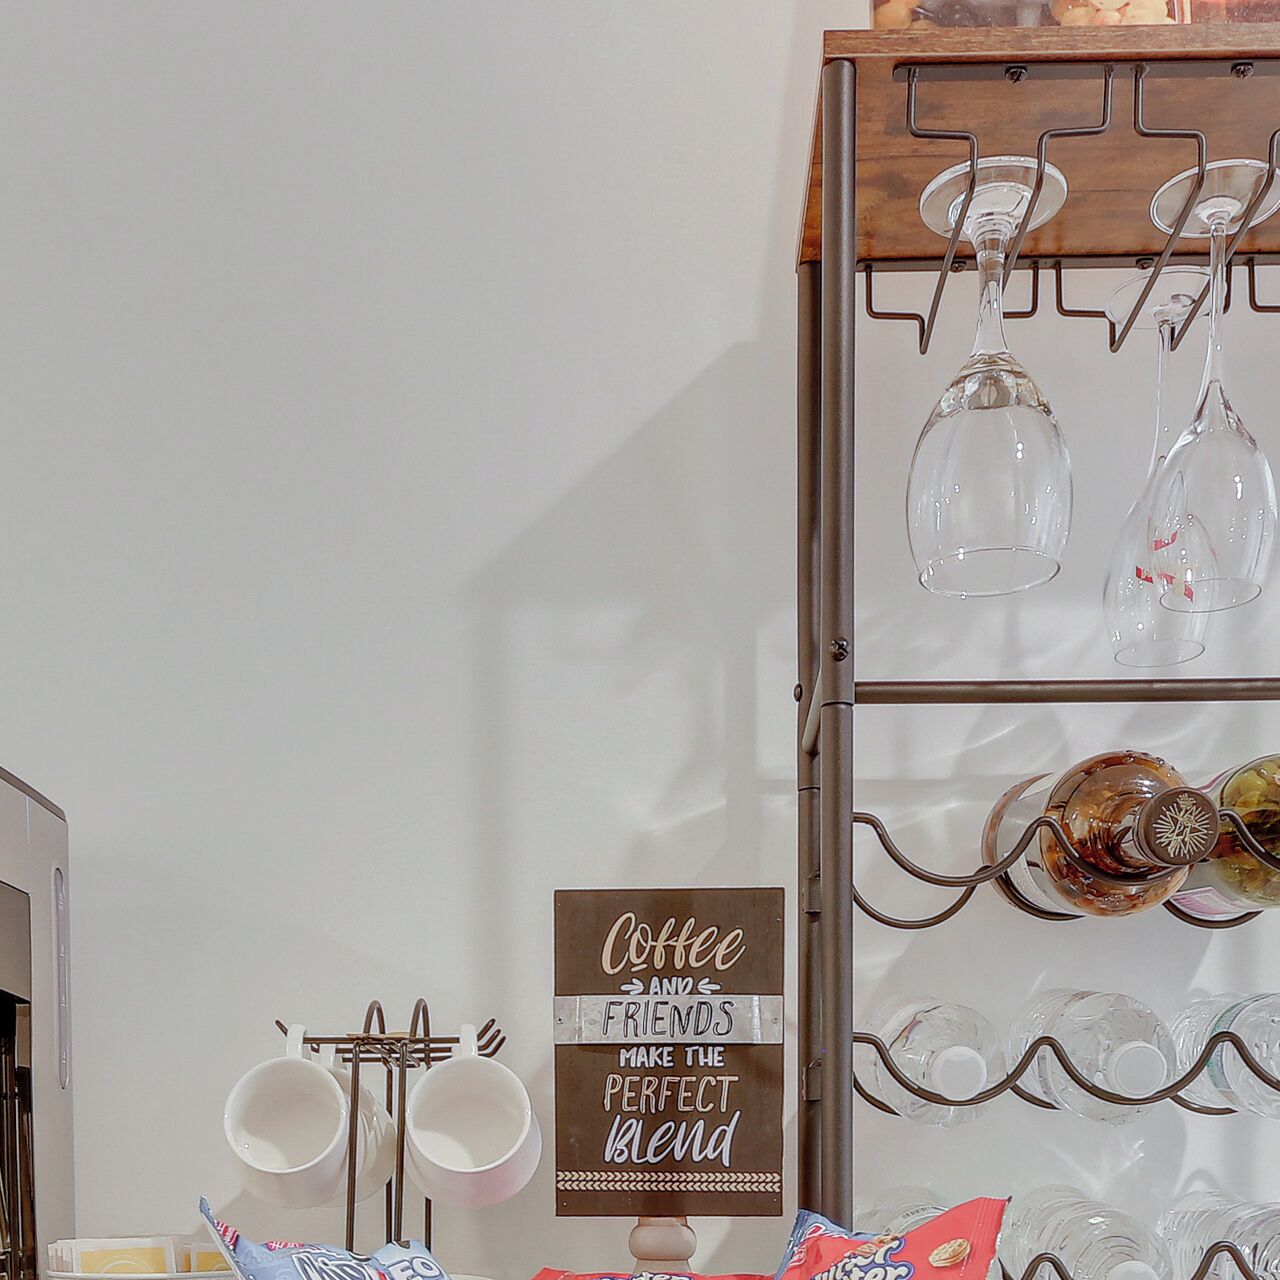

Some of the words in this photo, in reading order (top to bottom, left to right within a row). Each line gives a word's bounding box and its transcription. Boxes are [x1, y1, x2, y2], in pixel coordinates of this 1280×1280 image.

[601, 912, 747, 975] Coffee
[649, 976, 693, 995] AND
[601, 1000, 735, 1038] FRIENDS
[619, 1046, 674, 1068] MAKE
[685, 1046, 726, 1067] THE
[604, 1074, 740, 1114] PERFECT
